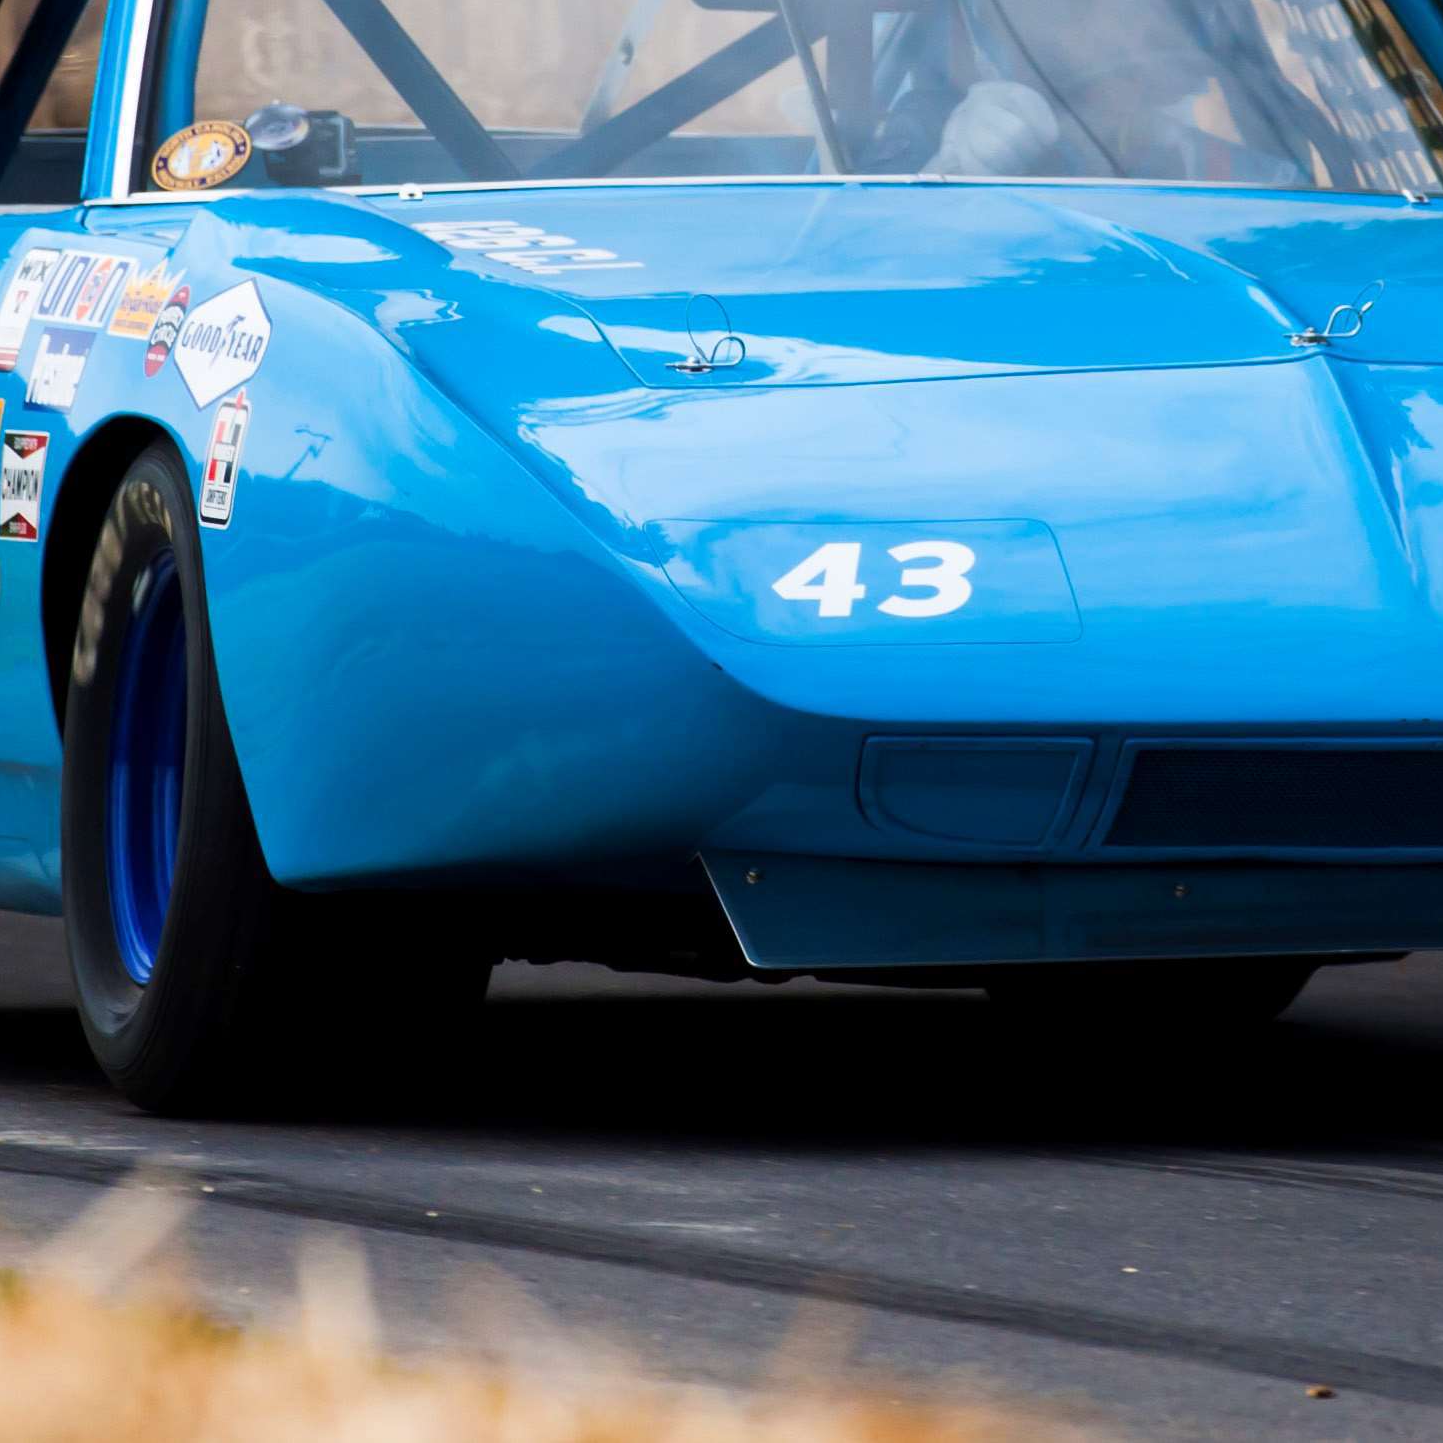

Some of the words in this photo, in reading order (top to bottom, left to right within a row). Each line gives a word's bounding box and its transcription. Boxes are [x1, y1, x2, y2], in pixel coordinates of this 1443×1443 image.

[19, 260, 54, 283] WIX
[181, 320, 264, 365] GOODYEAR
[2, 468, 39, 501] CHAMPION
[771, 540, 976, 617] 43
